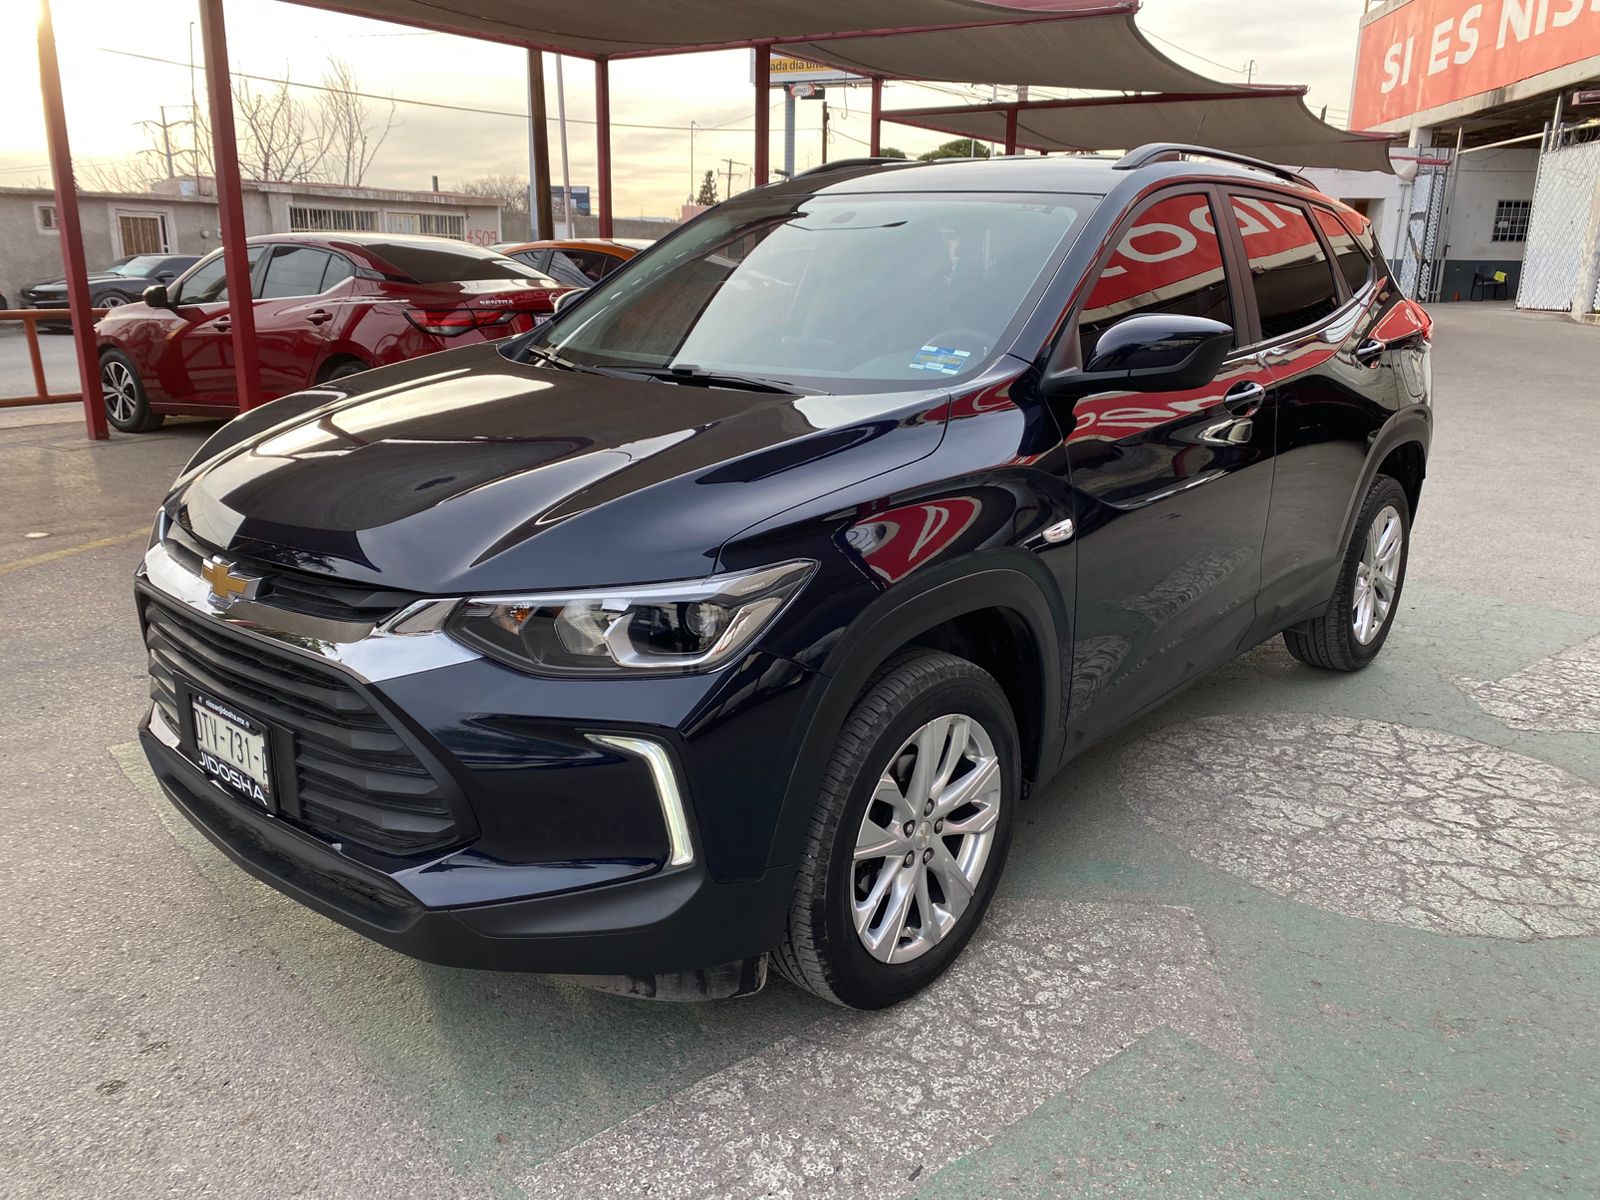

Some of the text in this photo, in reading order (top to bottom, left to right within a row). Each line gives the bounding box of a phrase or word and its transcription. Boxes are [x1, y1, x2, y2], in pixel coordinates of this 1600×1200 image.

[1380, 0, 1600, 94] SI ES NI
[769, 60, 787, 71] ada
[466, 229, 497, 246] 4509
[199, 751, 268, 806] JIDOSHA
